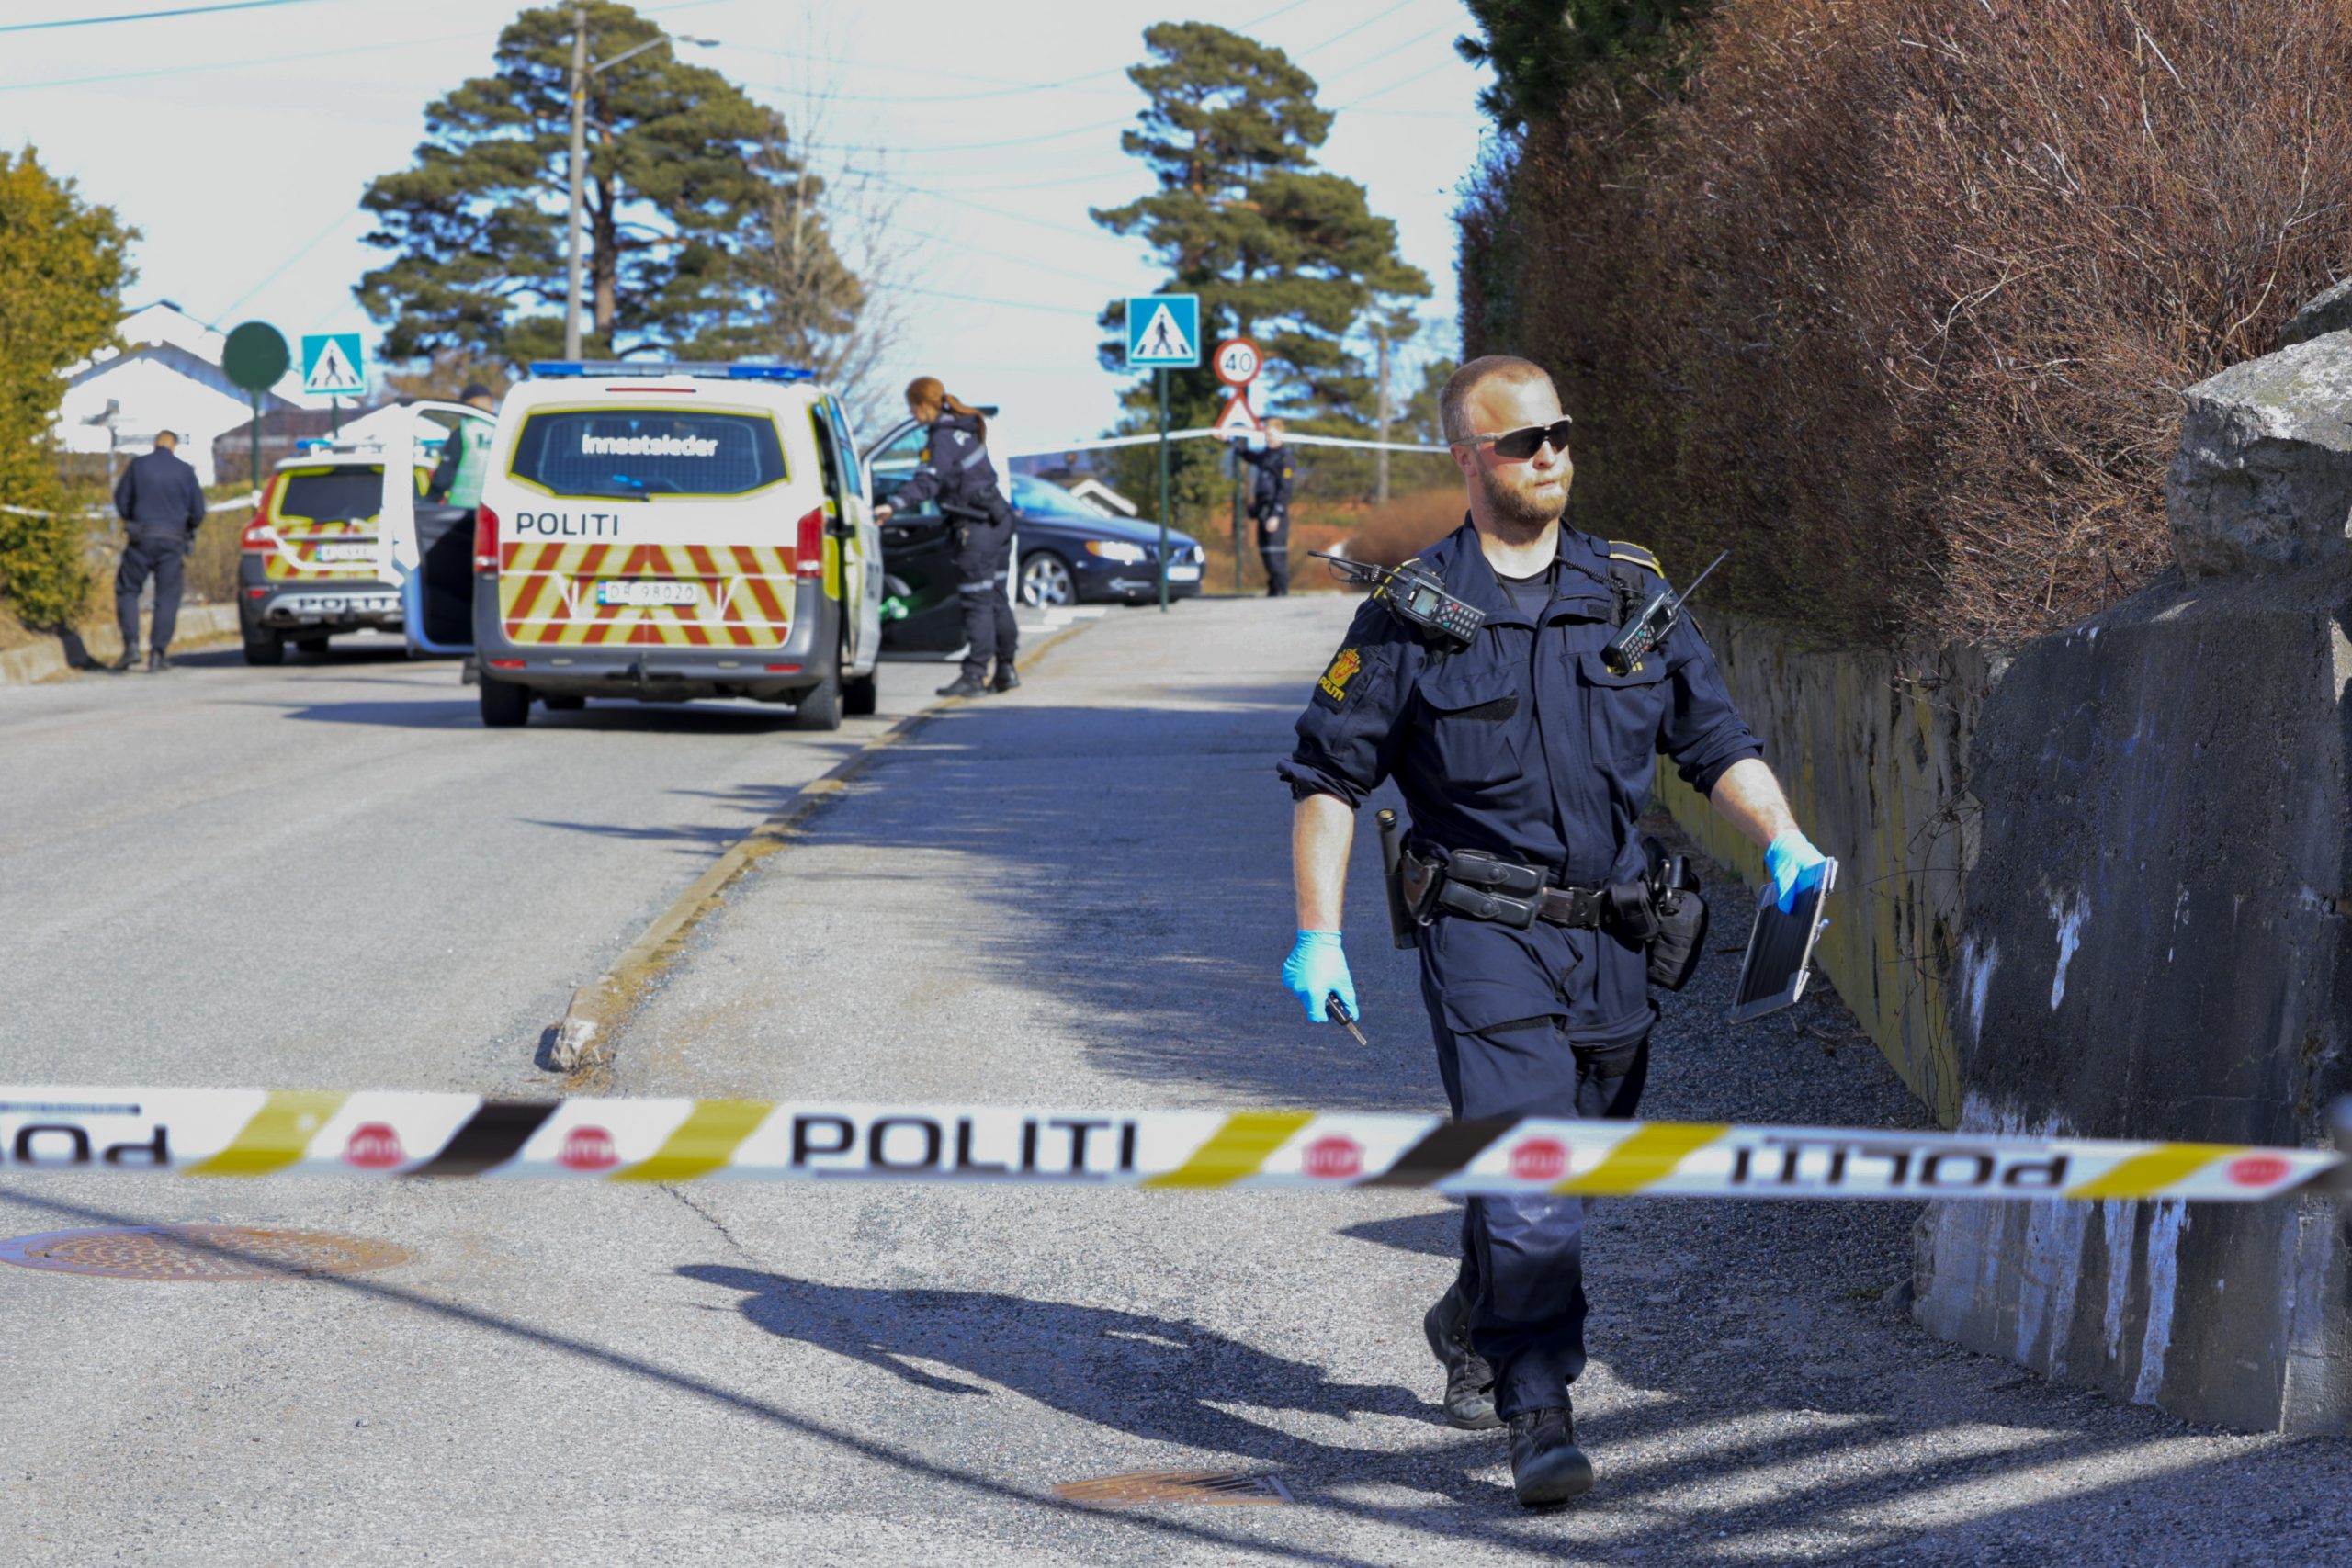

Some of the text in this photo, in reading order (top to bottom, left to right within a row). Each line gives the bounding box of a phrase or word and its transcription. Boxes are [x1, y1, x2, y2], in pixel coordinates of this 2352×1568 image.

[1224, 353, 1252, 372] 40
[516, 513, 618, 536] POLITI
[1318, 676, 1346, 702] POLITI
[793, 1114, 1136, 1174] POLITI
[1731, 1145, 2067, 1186] POLITI
